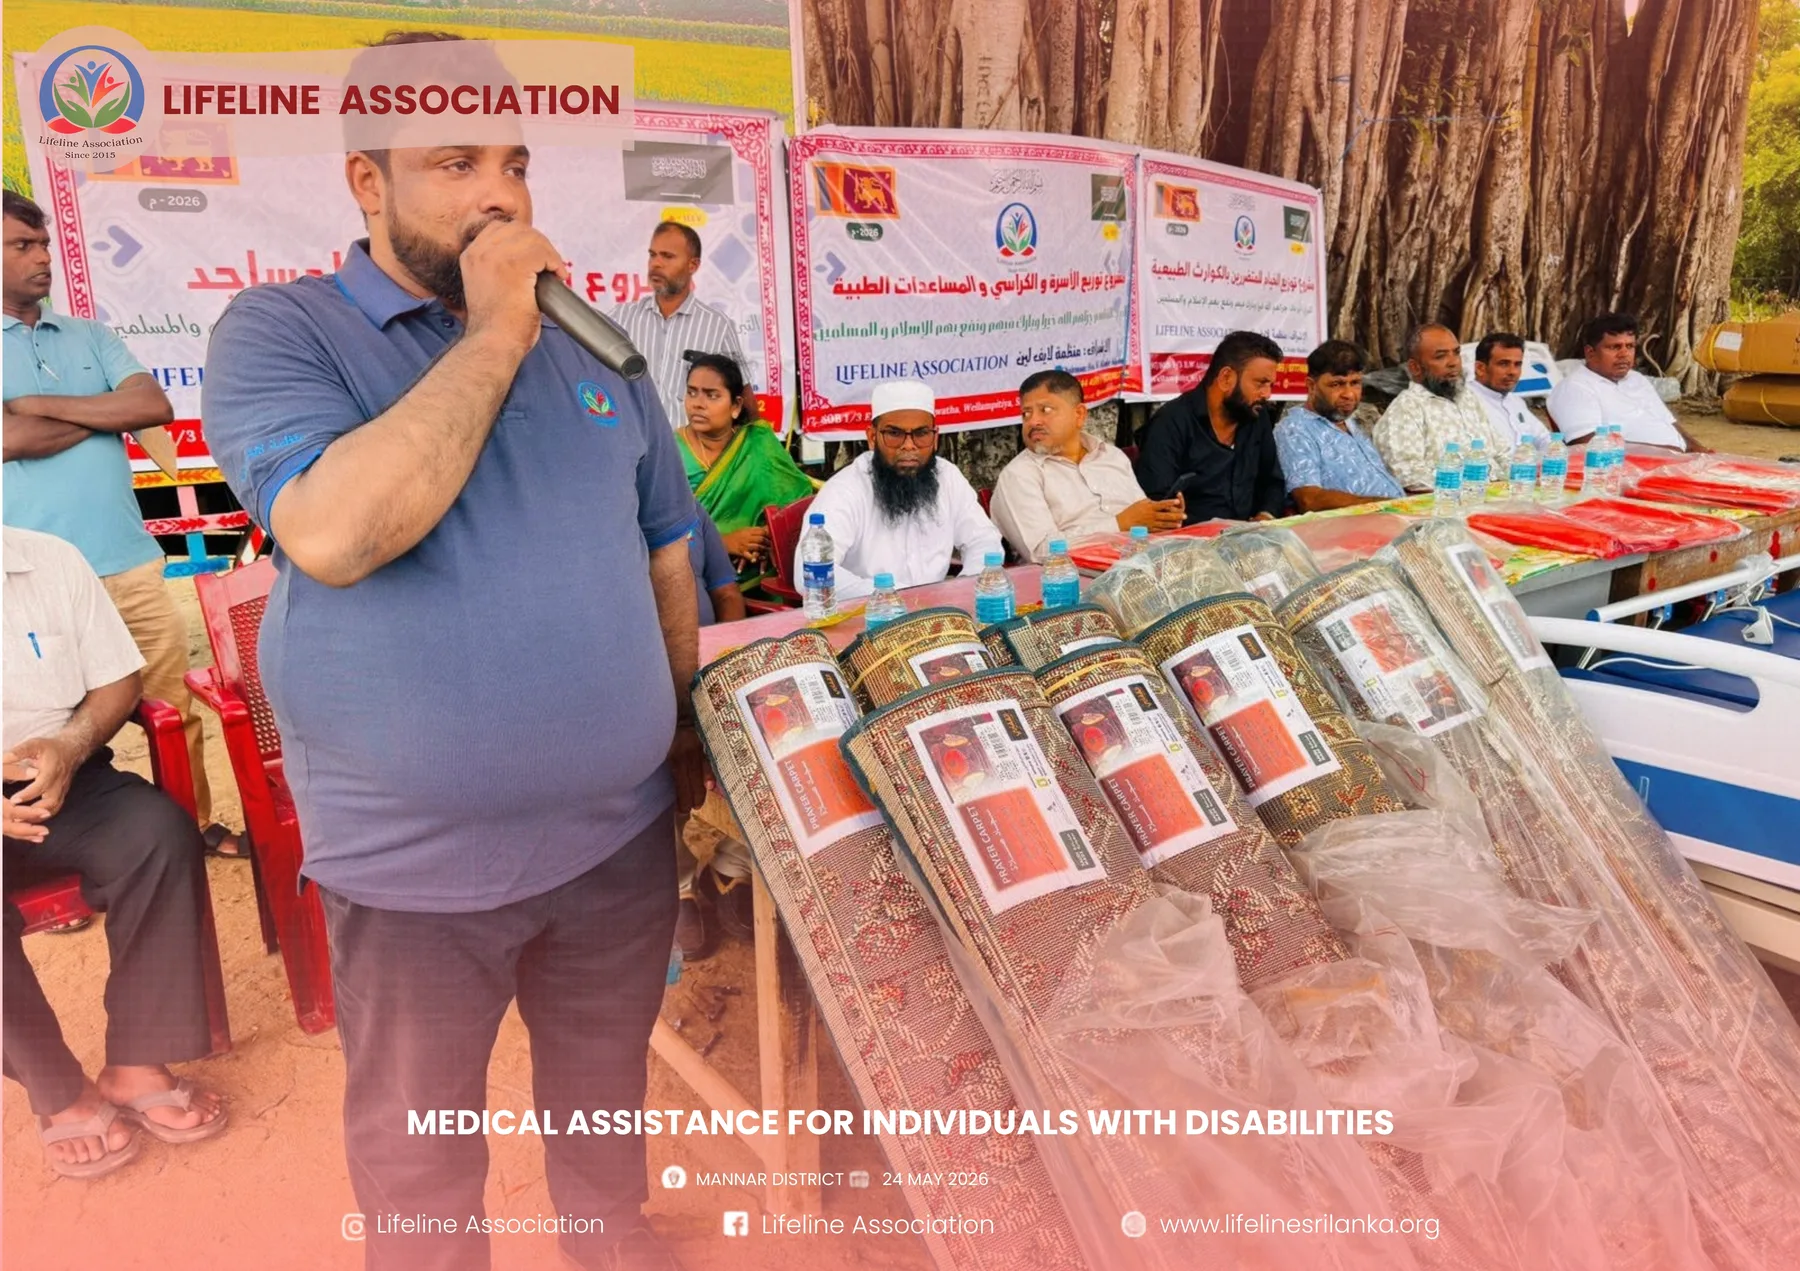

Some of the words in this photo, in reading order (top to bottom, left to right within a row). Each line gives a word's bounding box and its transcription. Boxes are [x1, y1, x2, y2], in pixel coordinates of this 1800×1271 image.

[167, 195, 201, 207] 2026
[833, 276, 890, 300] الطبية
[894, 275, 976, 296] المساعدات
[979, 283, 988, 298] و
[990, 273, 1038, 300] الكراسي
[1041, 280, 1047, 294] و
[1050, 269, 1080, 293] الأسرة
[1081, 271, 1103, 293] توزيع
[836, 362, 908, 386] LIFELINE
[911, 354, 1009, 380] ASSOCIATION
[1215, 725, 1237, 757] CARPET
[784, 759, 804, 794] CARPET
[1233, 756, 1255, 788] PRAYER
[1107, 777, 1131, 812] CARPET
[799, 793, 820, 830] PRAYER
[966, 804, 991, 844] CARPET
[1127, 811, 1151, 846] PRAYER
[986, 844, 1011, 885] PRAYER
